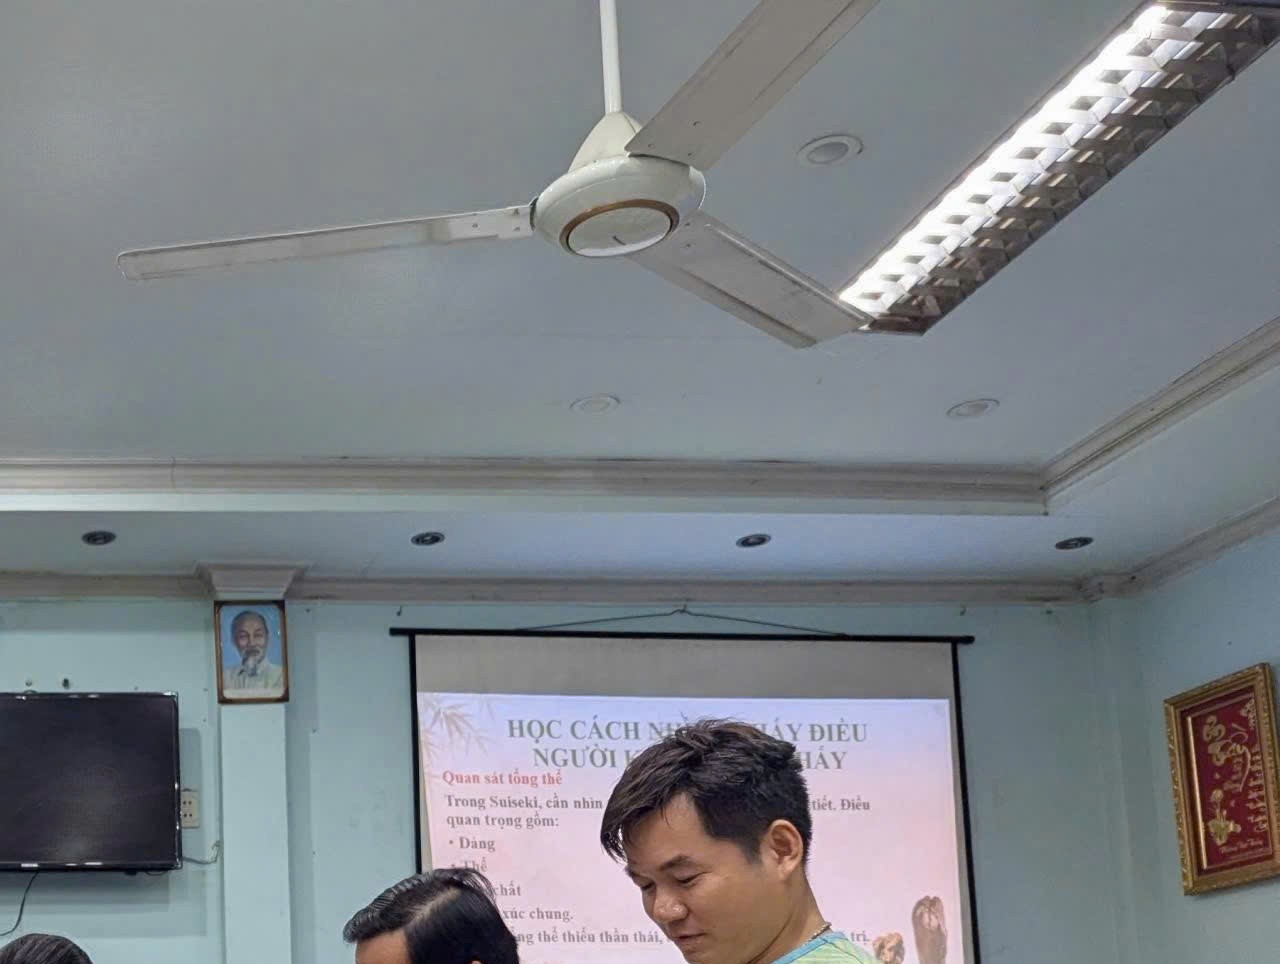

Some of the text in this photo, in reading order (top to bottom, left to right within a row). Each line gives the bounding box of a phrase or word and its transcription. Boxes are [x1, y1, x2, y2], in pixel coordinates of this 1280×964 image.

[507, 719, 562, 743] HỌC
[570, 714, 641, 740] CÁCH
[532, 743, 619, 768] NGƯỜI
[799, 745, 847, 770] HẤY
[442, 770, 480, 786] Quan
[484, 771, 503, 784] sát
[445, 794, 486, 810] Trong
[489, 795, 542, 810] Suiseki,
[446, 815, 480, 828] quan
[484, 814, 522, 830] trọng
[529, 907, 574, 923] chung.
